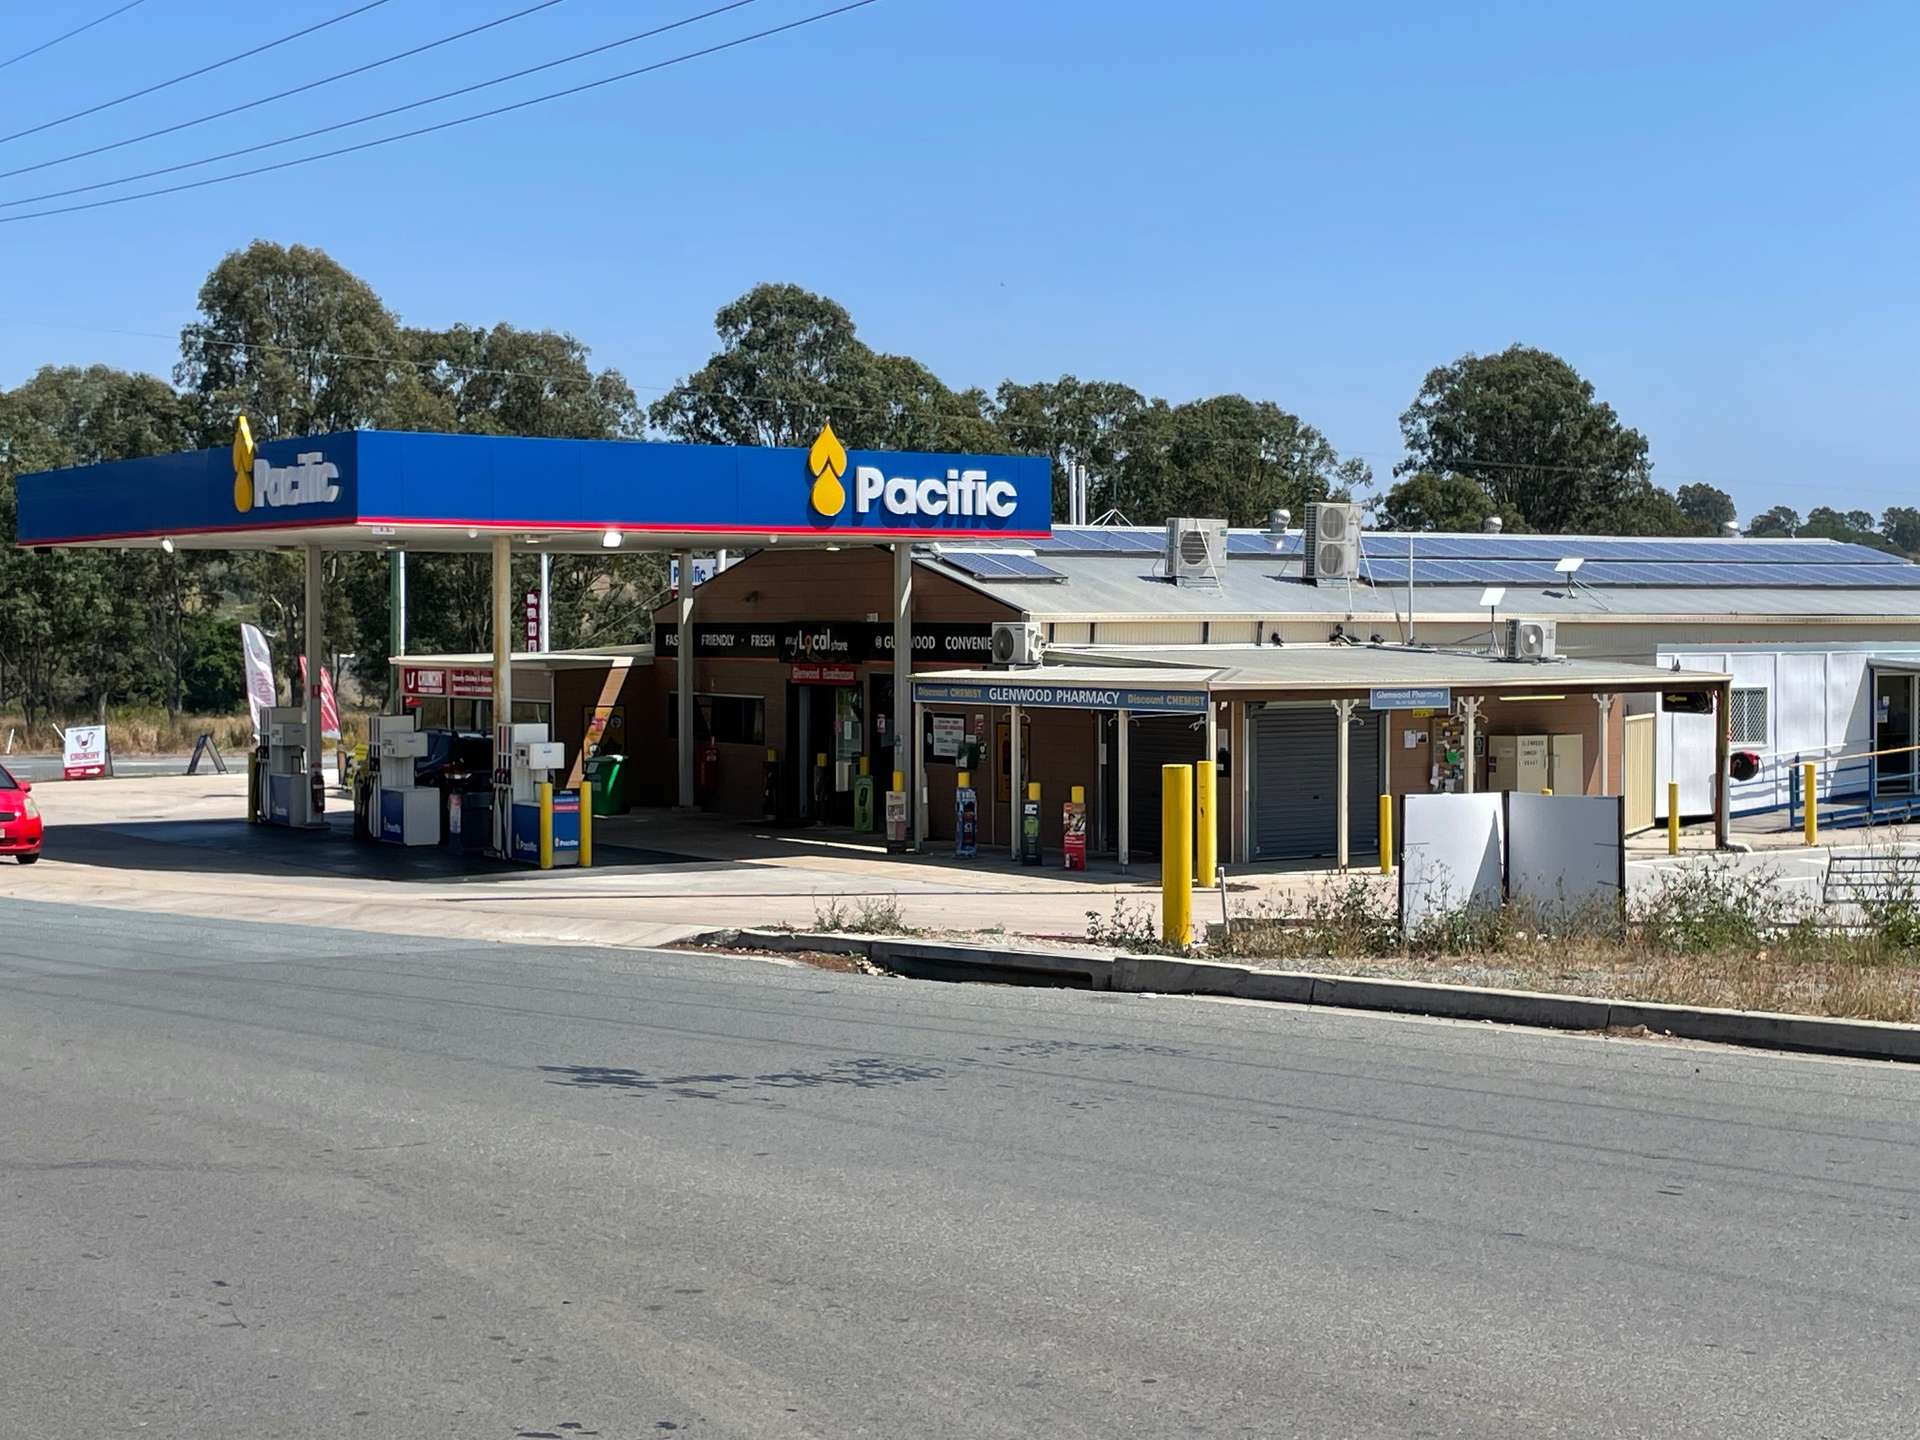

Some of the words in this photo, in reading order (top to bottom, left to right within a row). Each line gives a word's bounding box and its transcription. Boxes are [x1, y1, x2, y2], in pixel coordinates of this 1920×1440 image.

[253, 451, 339, 507] Pacific
[856, 466, 1018, 517] Pacific
[701, 634, 735, 647] FRIENDLY
[751, 635, 776, 648] FRESH
[785, 636, 799, 656] my
[799, 628, 831, 655] Local
[988, 687, 1052, 702] GLENWOOD
[1057, 689, 1120, 705] PHARMACY
[1127, 694, 1164, 705] Discount
[1166, 695, 1205, 706] CHEMIST
[1376, 690, 1411, 699] Glenwood
[1411, 690, 1444, 700] Pharmacy
